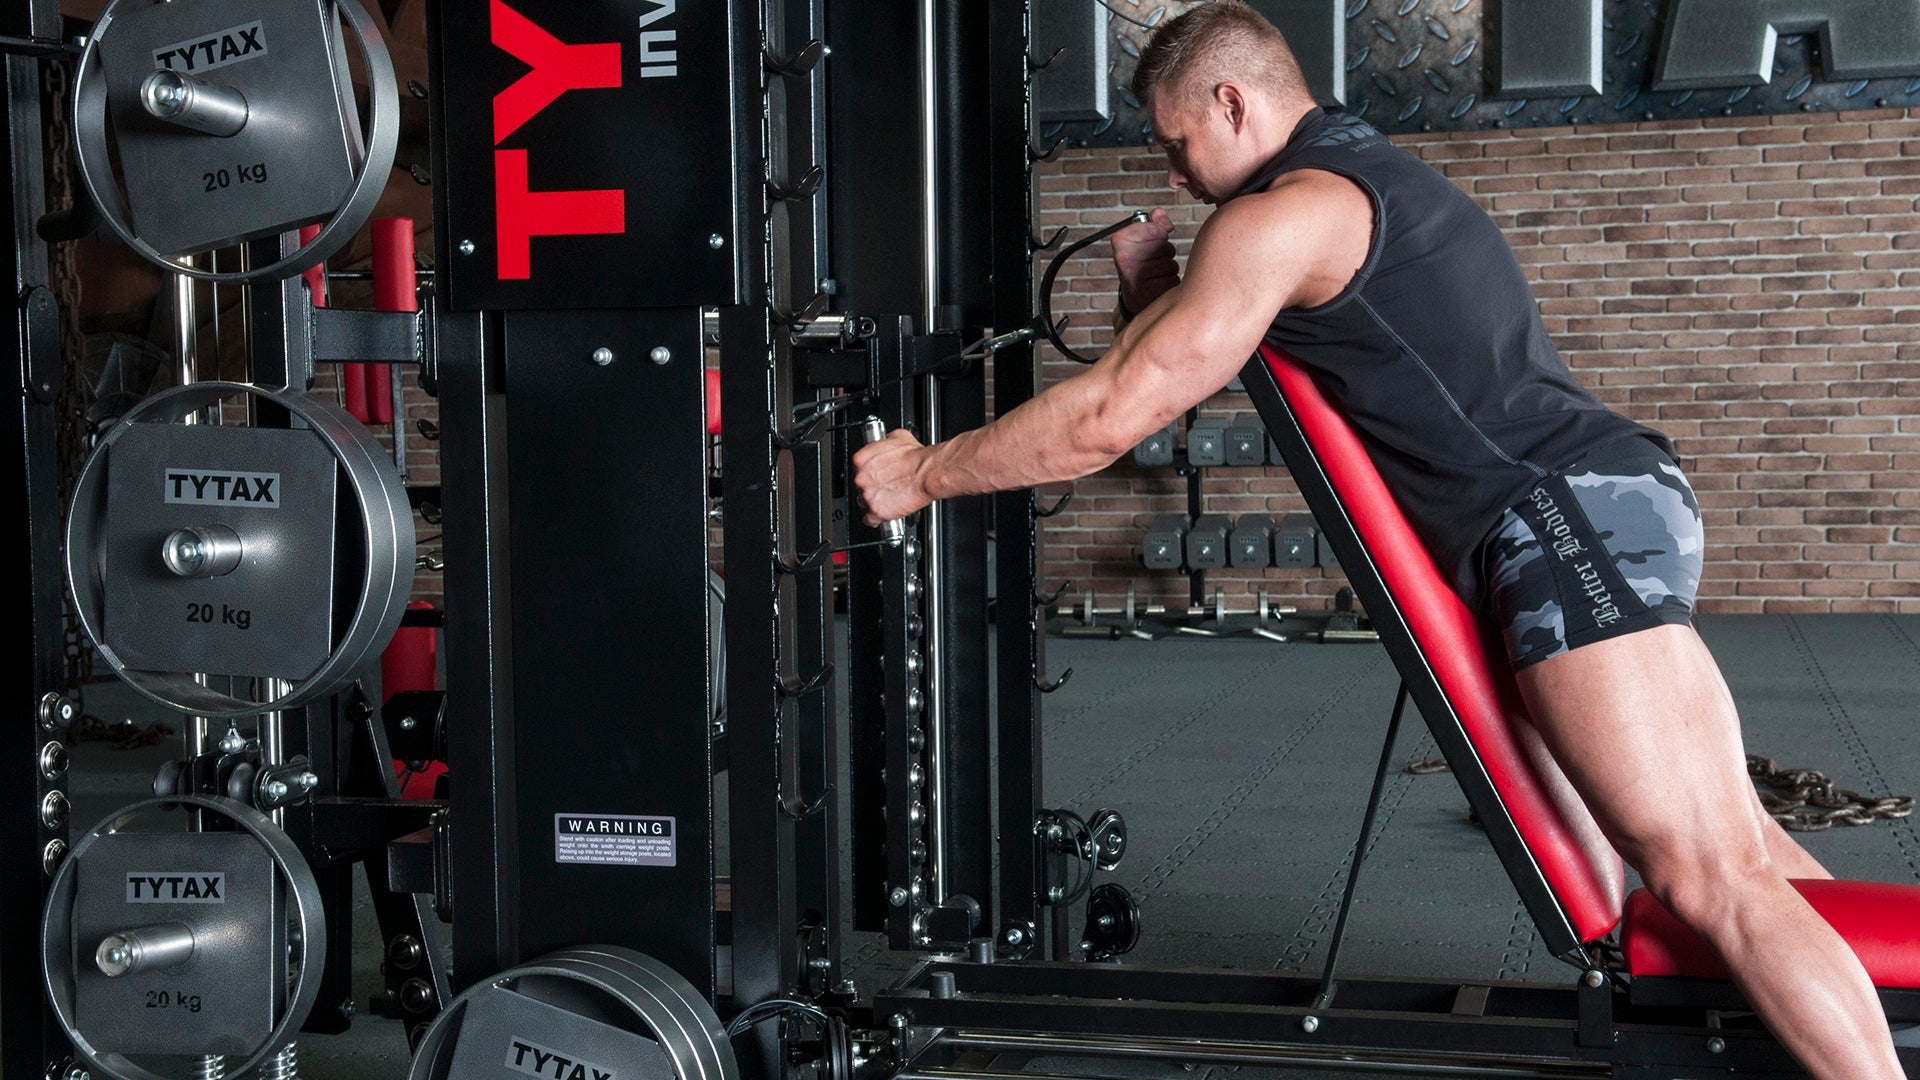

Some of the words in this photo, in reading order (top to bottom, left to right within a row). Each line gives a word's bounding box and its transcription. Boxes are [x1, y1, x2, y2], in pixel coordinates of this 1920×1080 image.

[156, 26, 263, 71] TYTAX
[202, 169, 230, 193] 20
[237, 163, 268, 184] kg
[168, 474, 275, 503] TYTAX
[1526, 487, 1588, 561] Bodies
[1574, 560, 1624, 628] Better
[186, 603, 214, 623] 20
[222, 604, 251, 630] kg
[568, 820, 663, 835] WARNING
[129, 877, 220, 899] TYTAX
[146, 991, 169, 1009] 20
[177, 991, 202, 1013] kg
